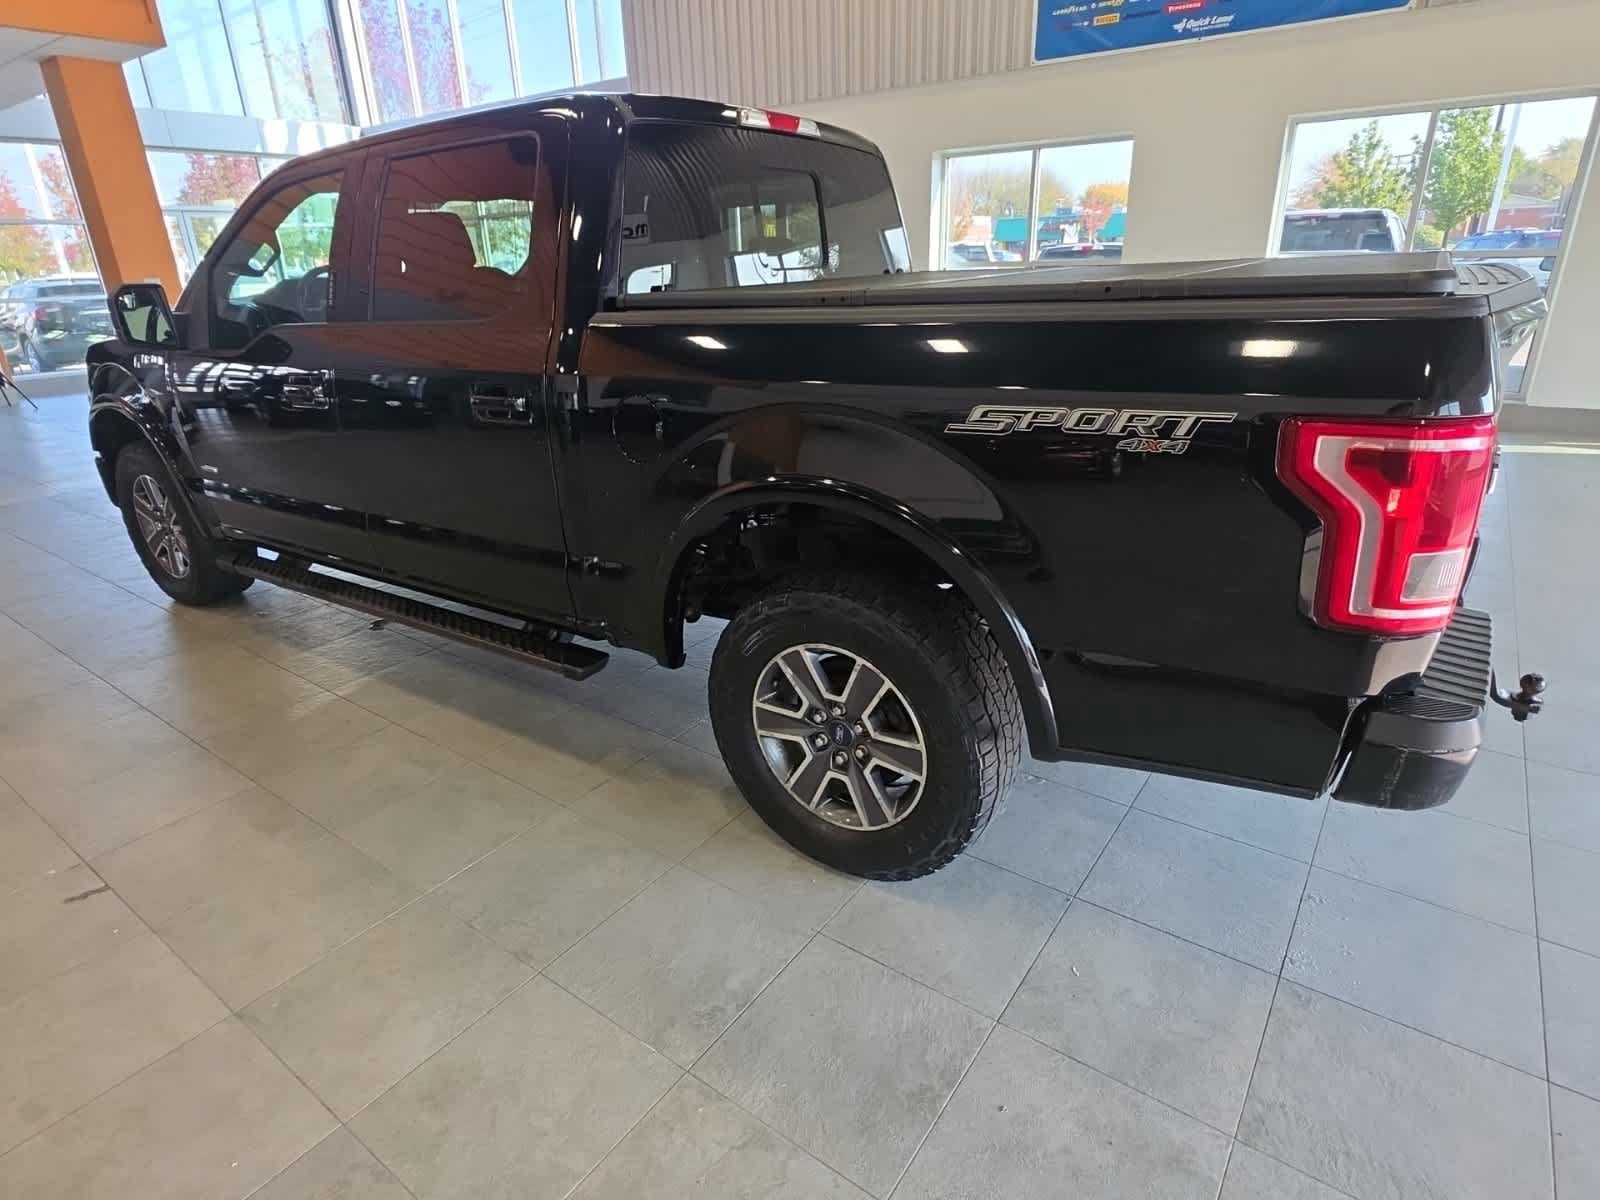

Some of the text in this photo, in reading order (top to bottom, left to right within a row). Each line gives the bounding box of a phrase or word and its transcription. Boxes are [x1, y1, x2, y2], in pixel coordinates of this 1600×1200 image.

[1186, 17, 1210, 28] Quick
[1210, 14, 1235, 24] Lane
[944, 404, 1237, 438] SPORT
